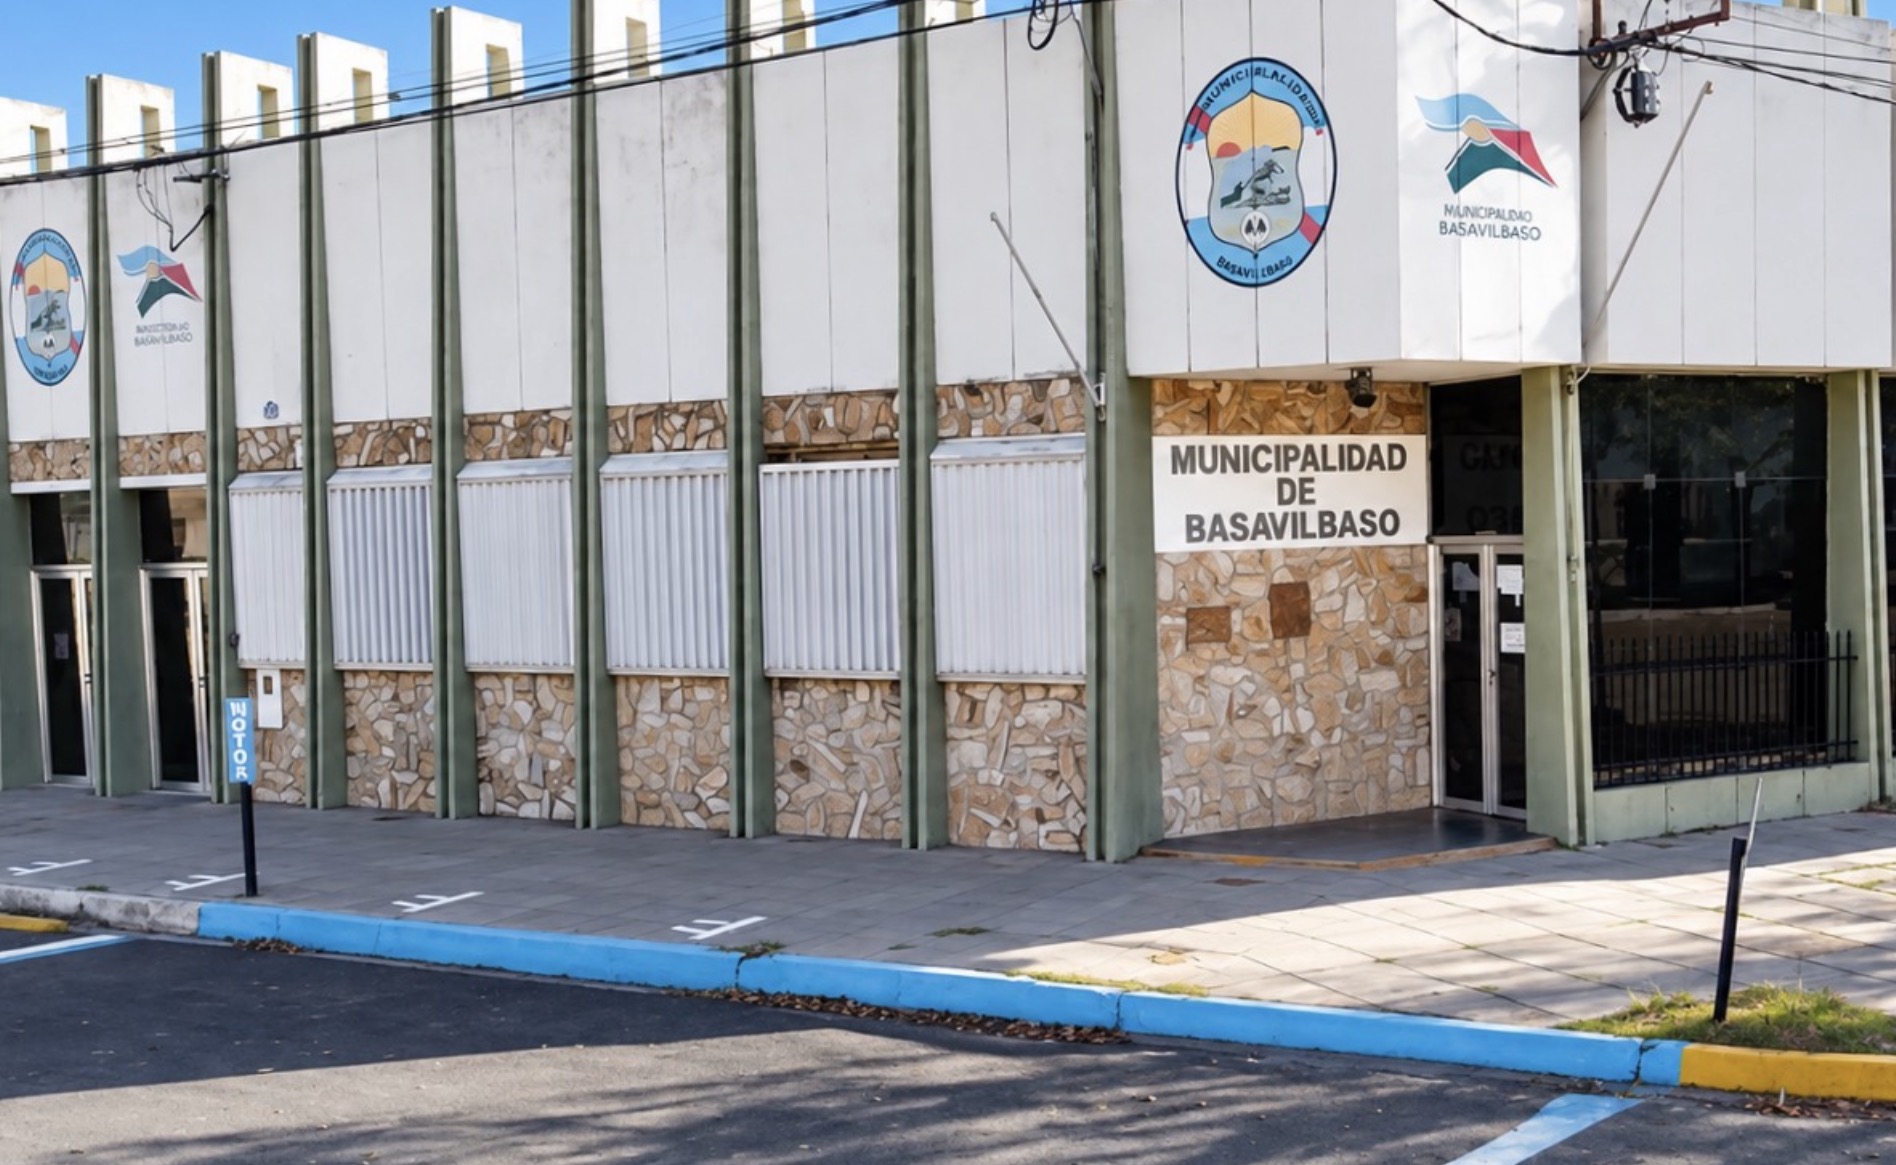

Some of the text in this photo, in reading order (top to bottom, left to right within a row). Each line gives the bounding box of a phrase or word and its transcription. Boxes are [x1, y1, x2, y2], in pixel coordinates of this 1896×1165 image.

[1438, 220, 1542, 241] BASAVILBASO
[1170, 443, 1407, 475] MUNICIPALIDAD
[1277, 477, 1316, 506] DE
[1185, 508, 1401, 543] BASAVILBASO
